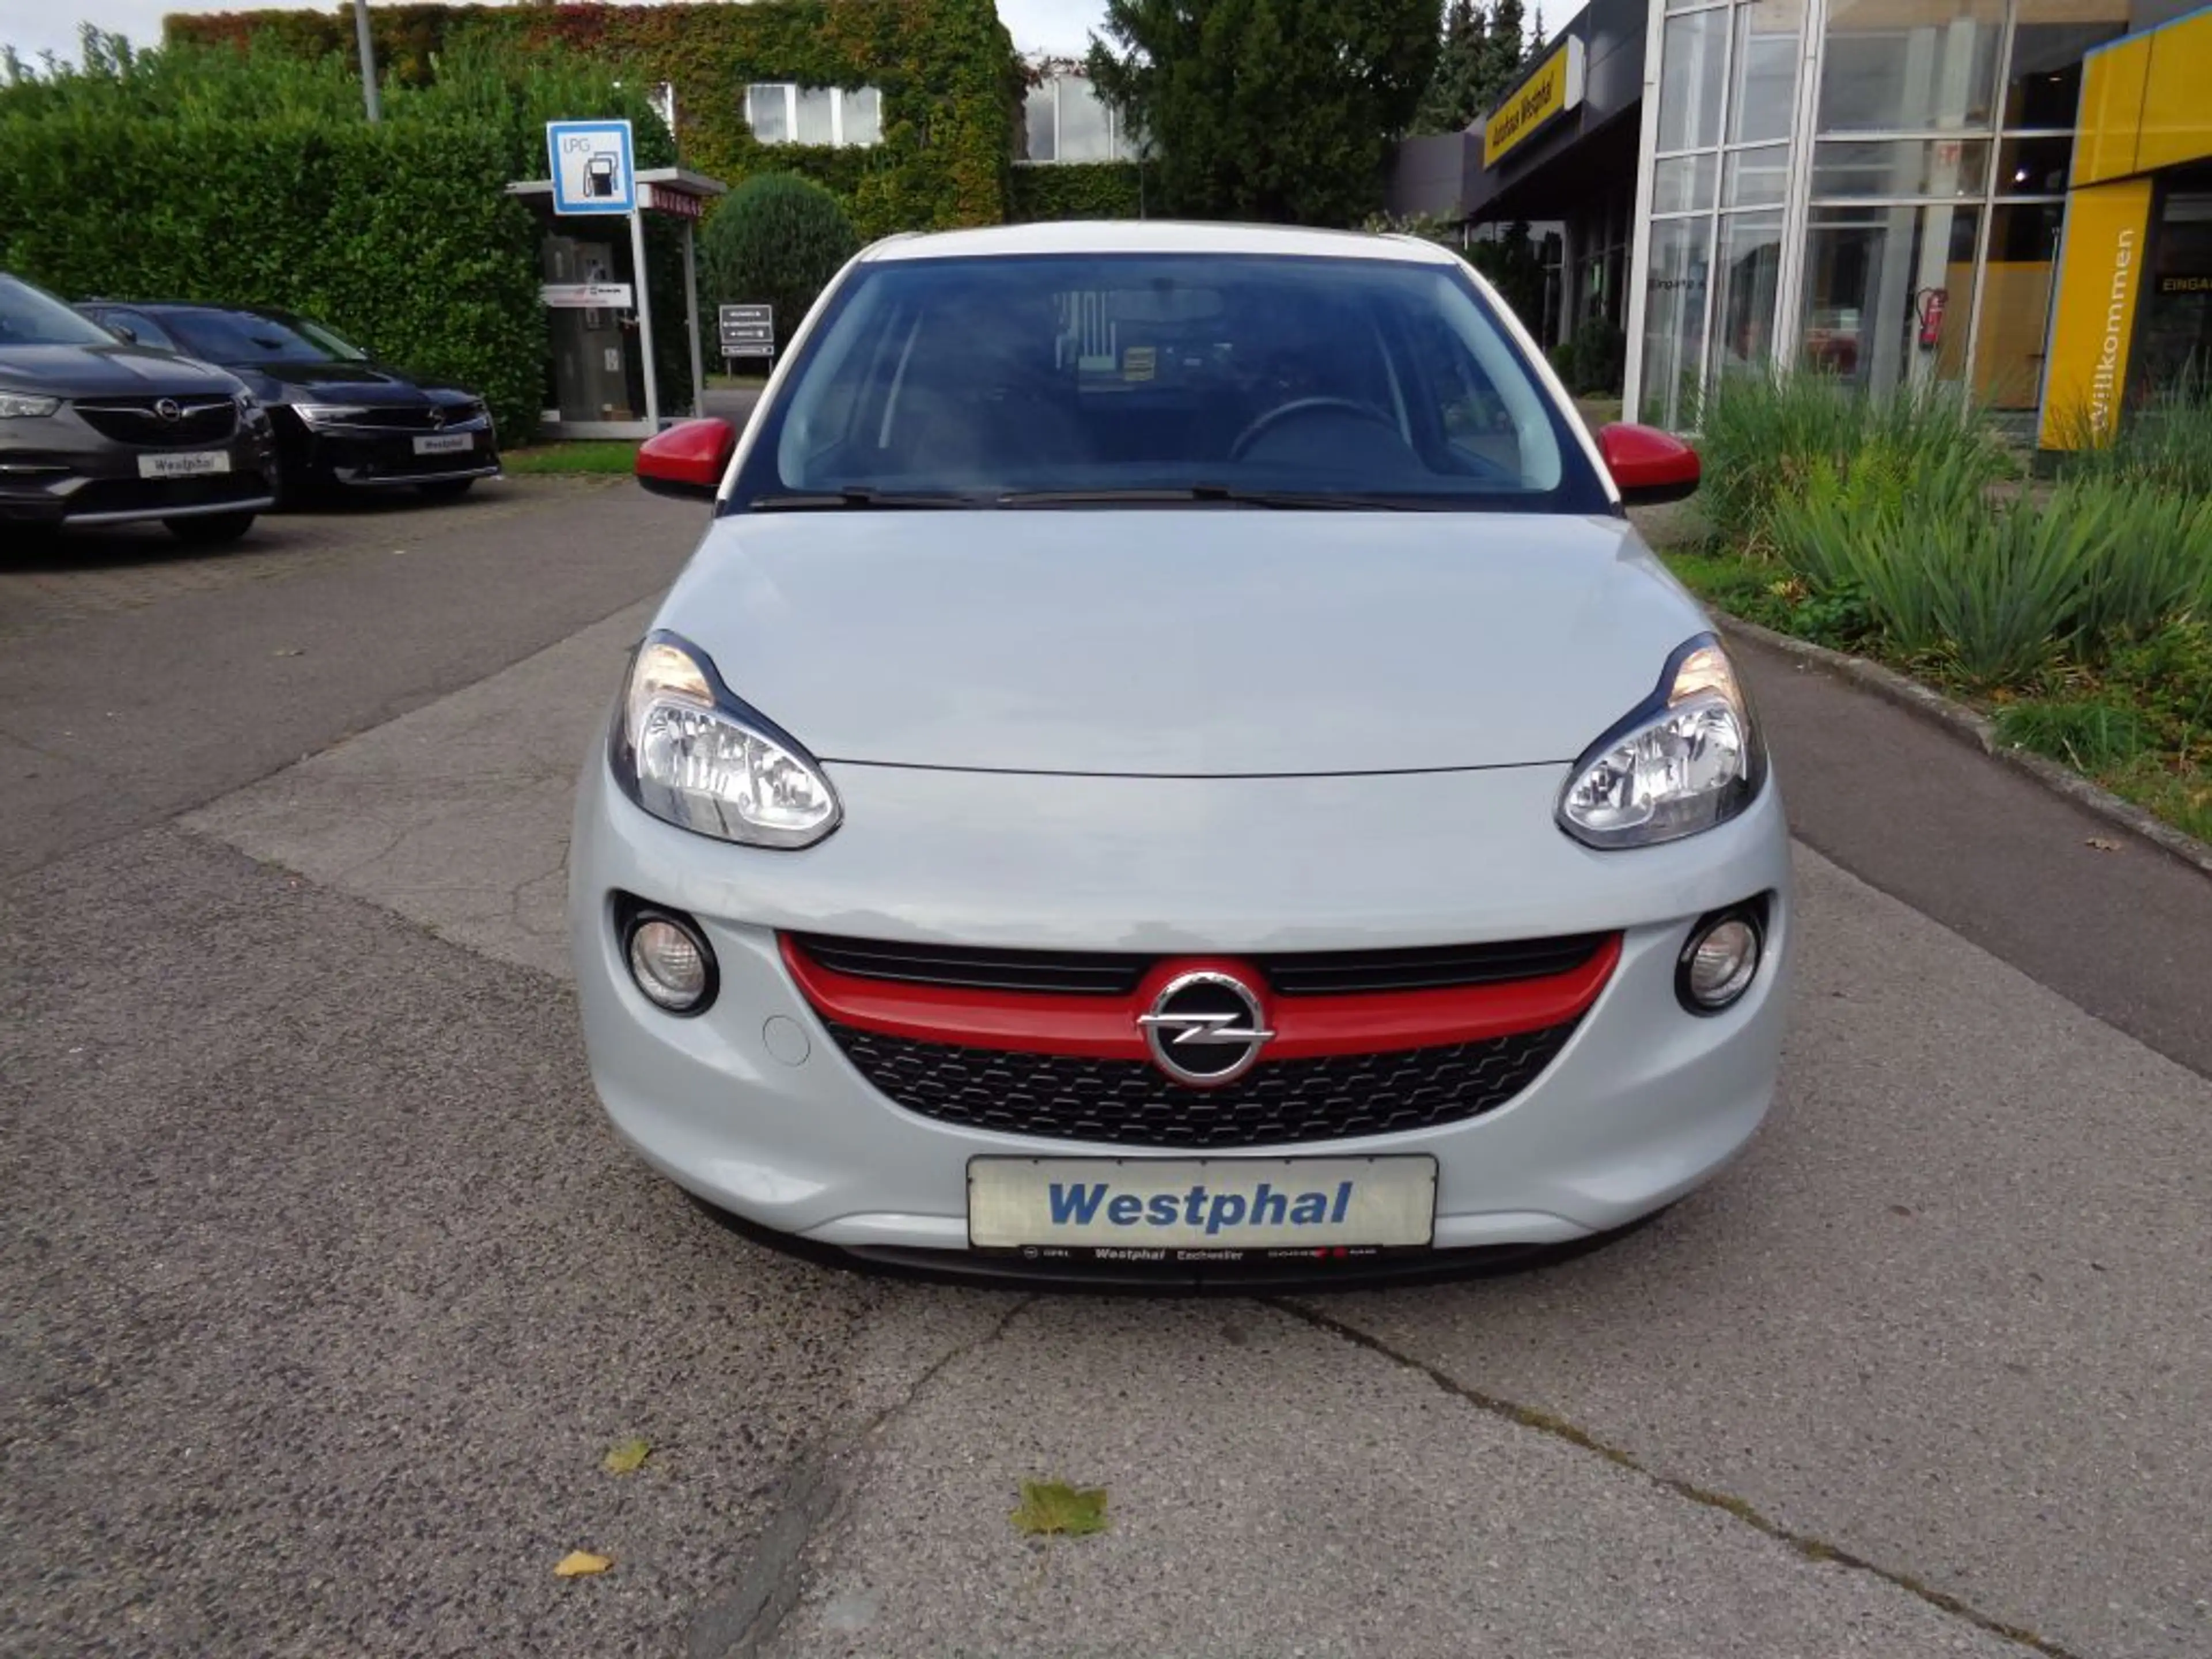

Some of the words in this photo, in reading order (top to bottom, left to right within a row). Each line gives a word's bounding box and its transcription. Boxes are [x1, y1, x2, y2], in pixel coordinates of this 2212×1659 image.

[563, 138, 590, 154] LPG
[2163, 277, 2212, 290] EINGA
[1048, 1181, 1354, 1234] Westphal
[1094, 1248, 1165, 1260] Westphal
